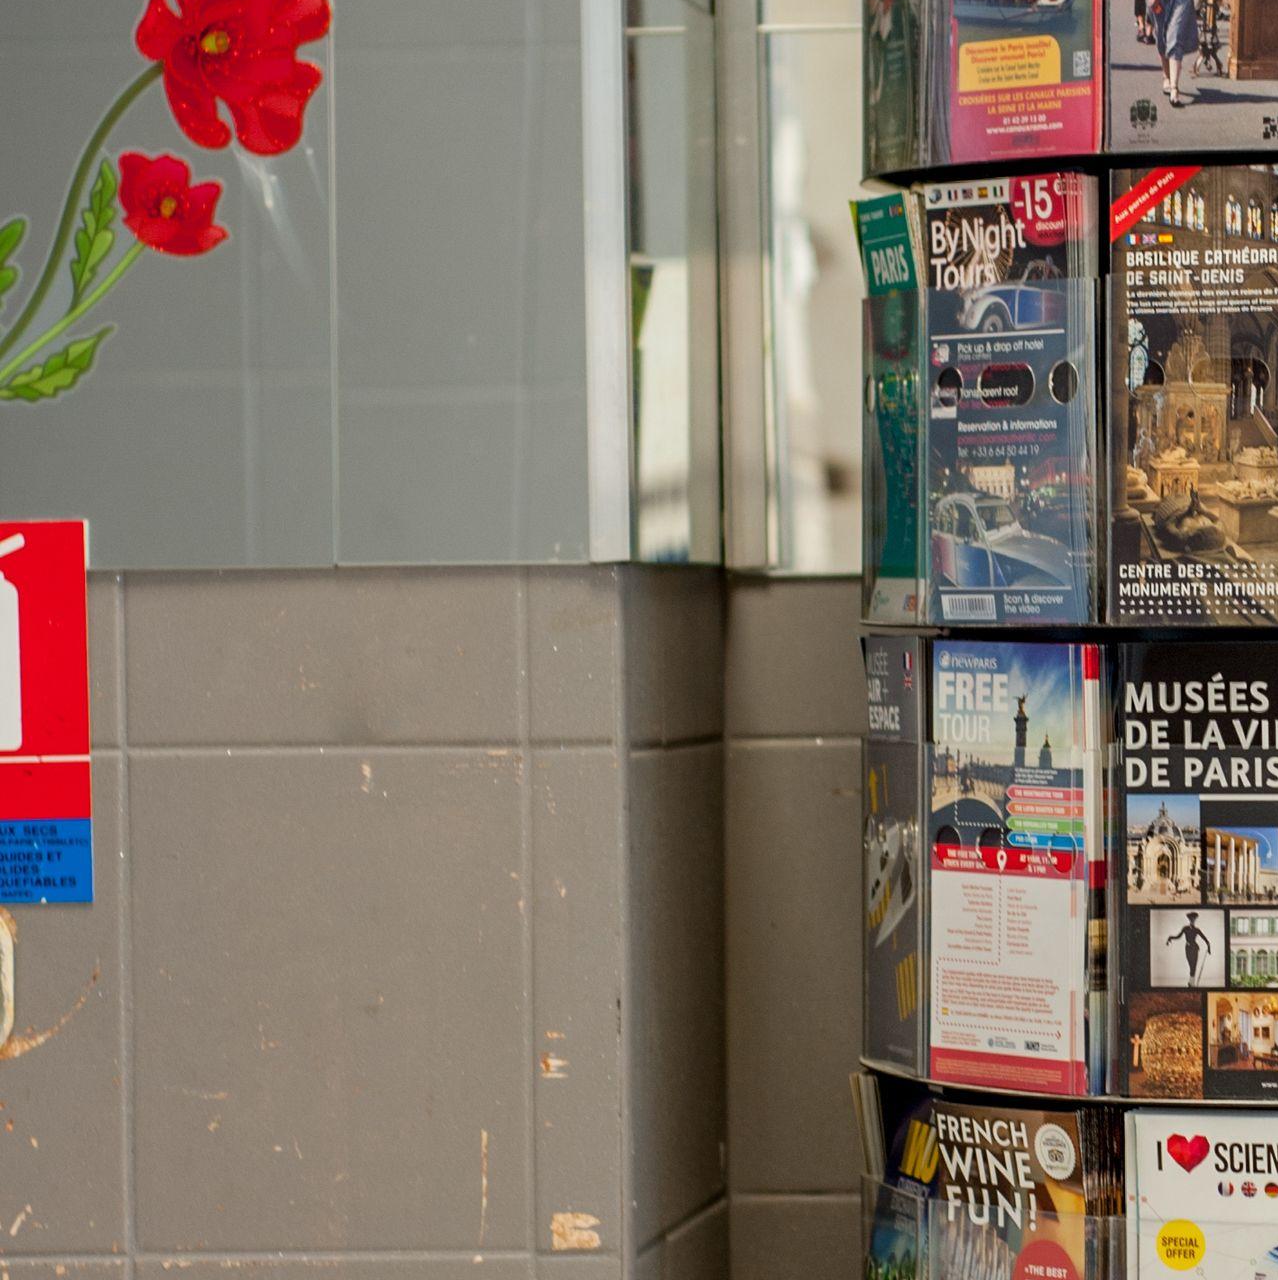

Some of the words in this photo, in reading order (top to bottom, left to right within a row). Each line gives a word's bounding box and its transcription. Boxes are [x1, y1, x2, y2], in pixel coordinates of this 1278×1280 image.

[931, 220, 959, 261] By
[962, 217, 1026, 257] Night
[871, 244, 909, 286] PARIS
[931, 258, 1000, 290] Tours
[1126, 250, 1200, 268] BASILIQUE
[1126, 271, 1144, 286] DE
[1150, 268, 1244, 285] SAINT-DENIS
[1119, 564, 1171, 578] CENTRE
[1178, 564, 1204, 578] DES
[1119, 582, 1208, 597] MONUMENTS
[939, 671, 1009, 713] FREE
[1125, 672, 1270, 713] MUSÉES
[869, 705, 900, 731] ESPACE
[940, 713, 991, 743] TOUR
[1125, 720, 1170, 750] DE
[1184, 720, 1226, 750] LA
[1125, 757, 1170, 788] DE
[0, 865, 39, 875] LIDES
[0, 876, 77, 888] QUEFIABLES
[936, 1113, 1028, 1149] FRENCH
[938, 1143, 1036, 1189] WINE
[946, 1184, 1037, 1232] FUN!
[1161, 1235, 1199, 1249] SPECIAL
[1165, 1248, 1197, 1261] OFFER
